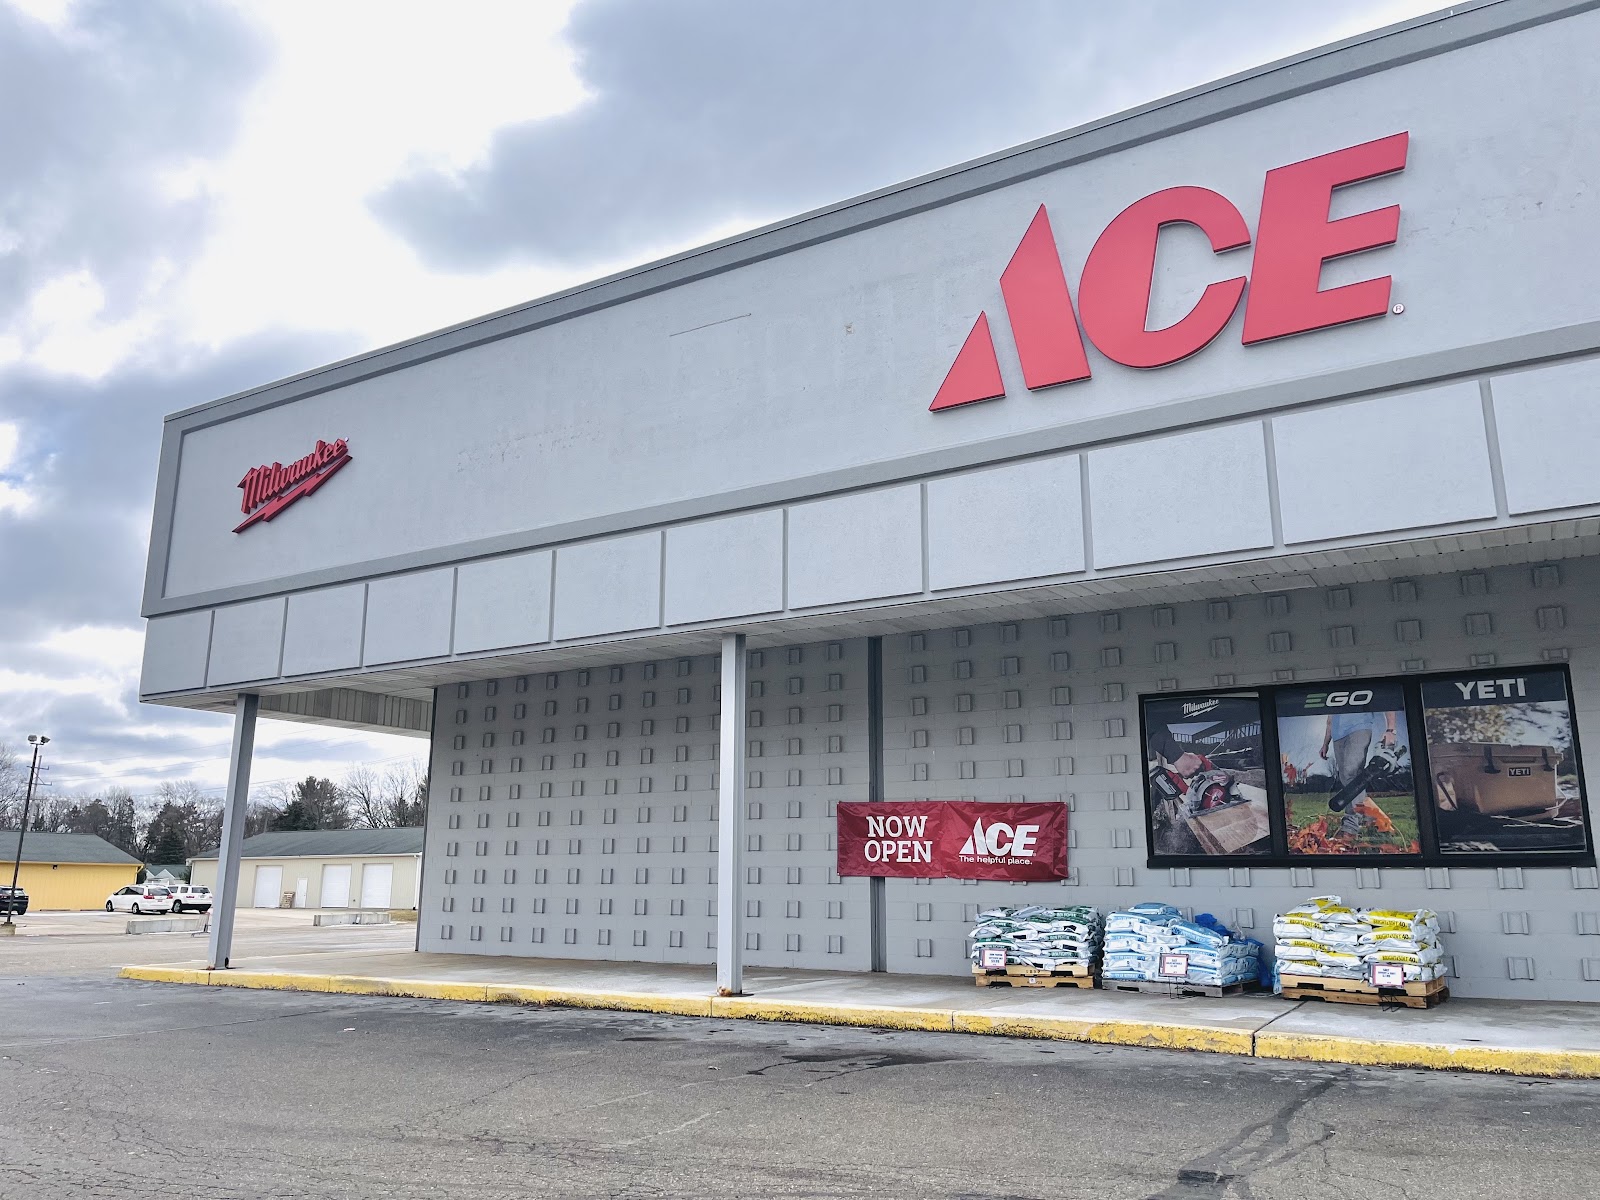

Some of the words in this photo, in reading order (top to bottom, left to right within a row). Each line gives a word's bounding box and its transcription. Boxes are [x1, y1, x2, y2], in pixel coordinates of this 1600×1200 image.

[928, 131, 1409, 413] ACE
[237, 438, 349, 514] Milwaukee
[1304, 690, 1373, 709] EGO
[1454, 678, 1526, 700] YETI
[1181, 698, 1220, 715] Milwaukee
[1509, 768, 1530, 776] YETI
[866, 815, 928, 838] NOW
[959, 816, 1040, 857] ACE
[864, 840, 933, 863] OPEN
[959, 855, 975, 863] The
[976, 855, 1006, 865] helpful
[1007, 857, 1033, 866] place.
